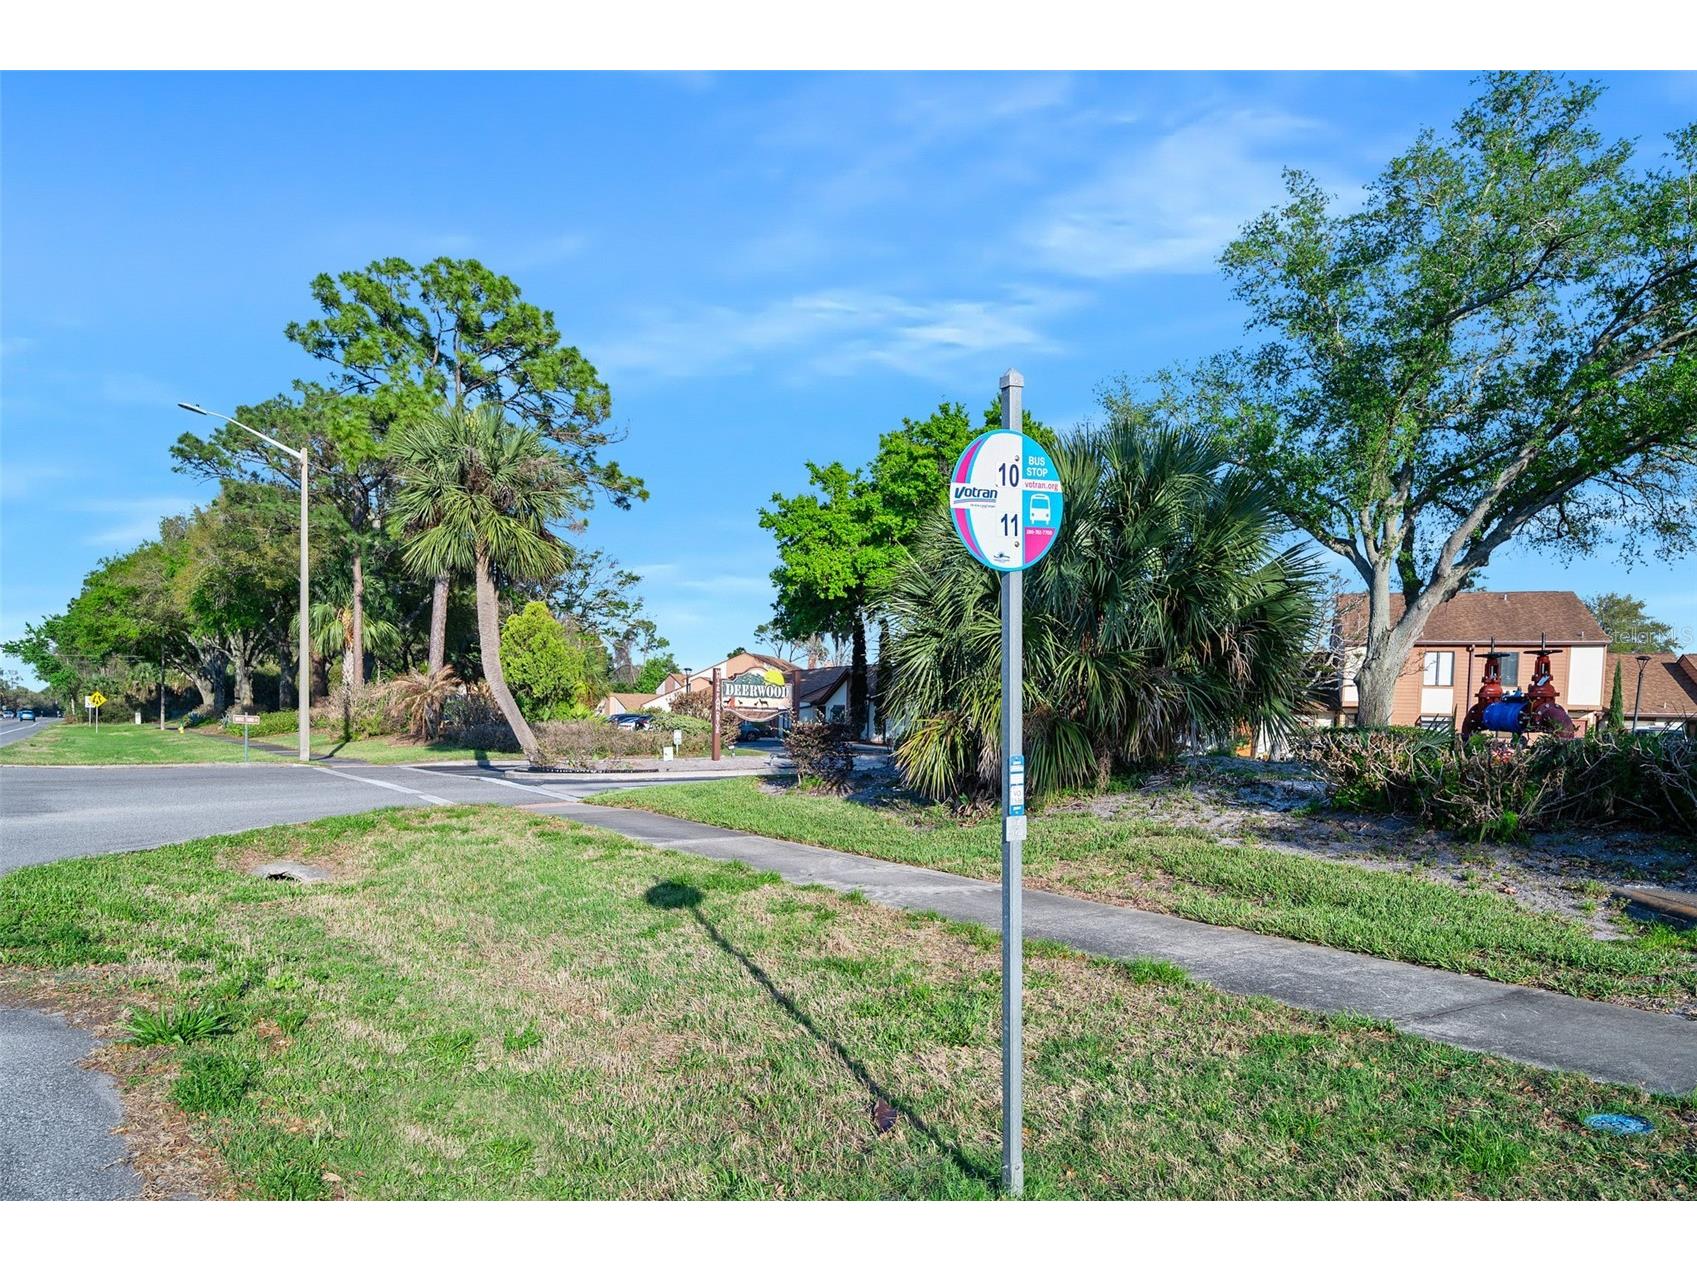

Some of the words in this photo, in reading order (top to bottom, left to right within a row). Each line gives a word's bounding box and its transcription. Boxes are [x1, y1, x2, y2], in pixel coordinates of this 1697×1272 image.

[1028, 455, 1045, 466] BUS
[998, 463, 1020, 487] 10
[1026, 467, 1048, 477] STOP
[954, 486, 998, 499] Votran
[1024, 481, 1059, 491] votran.org
[1000, 513, 1018, 537] 11
[725, 683, 790, 698] DEERWOOD
